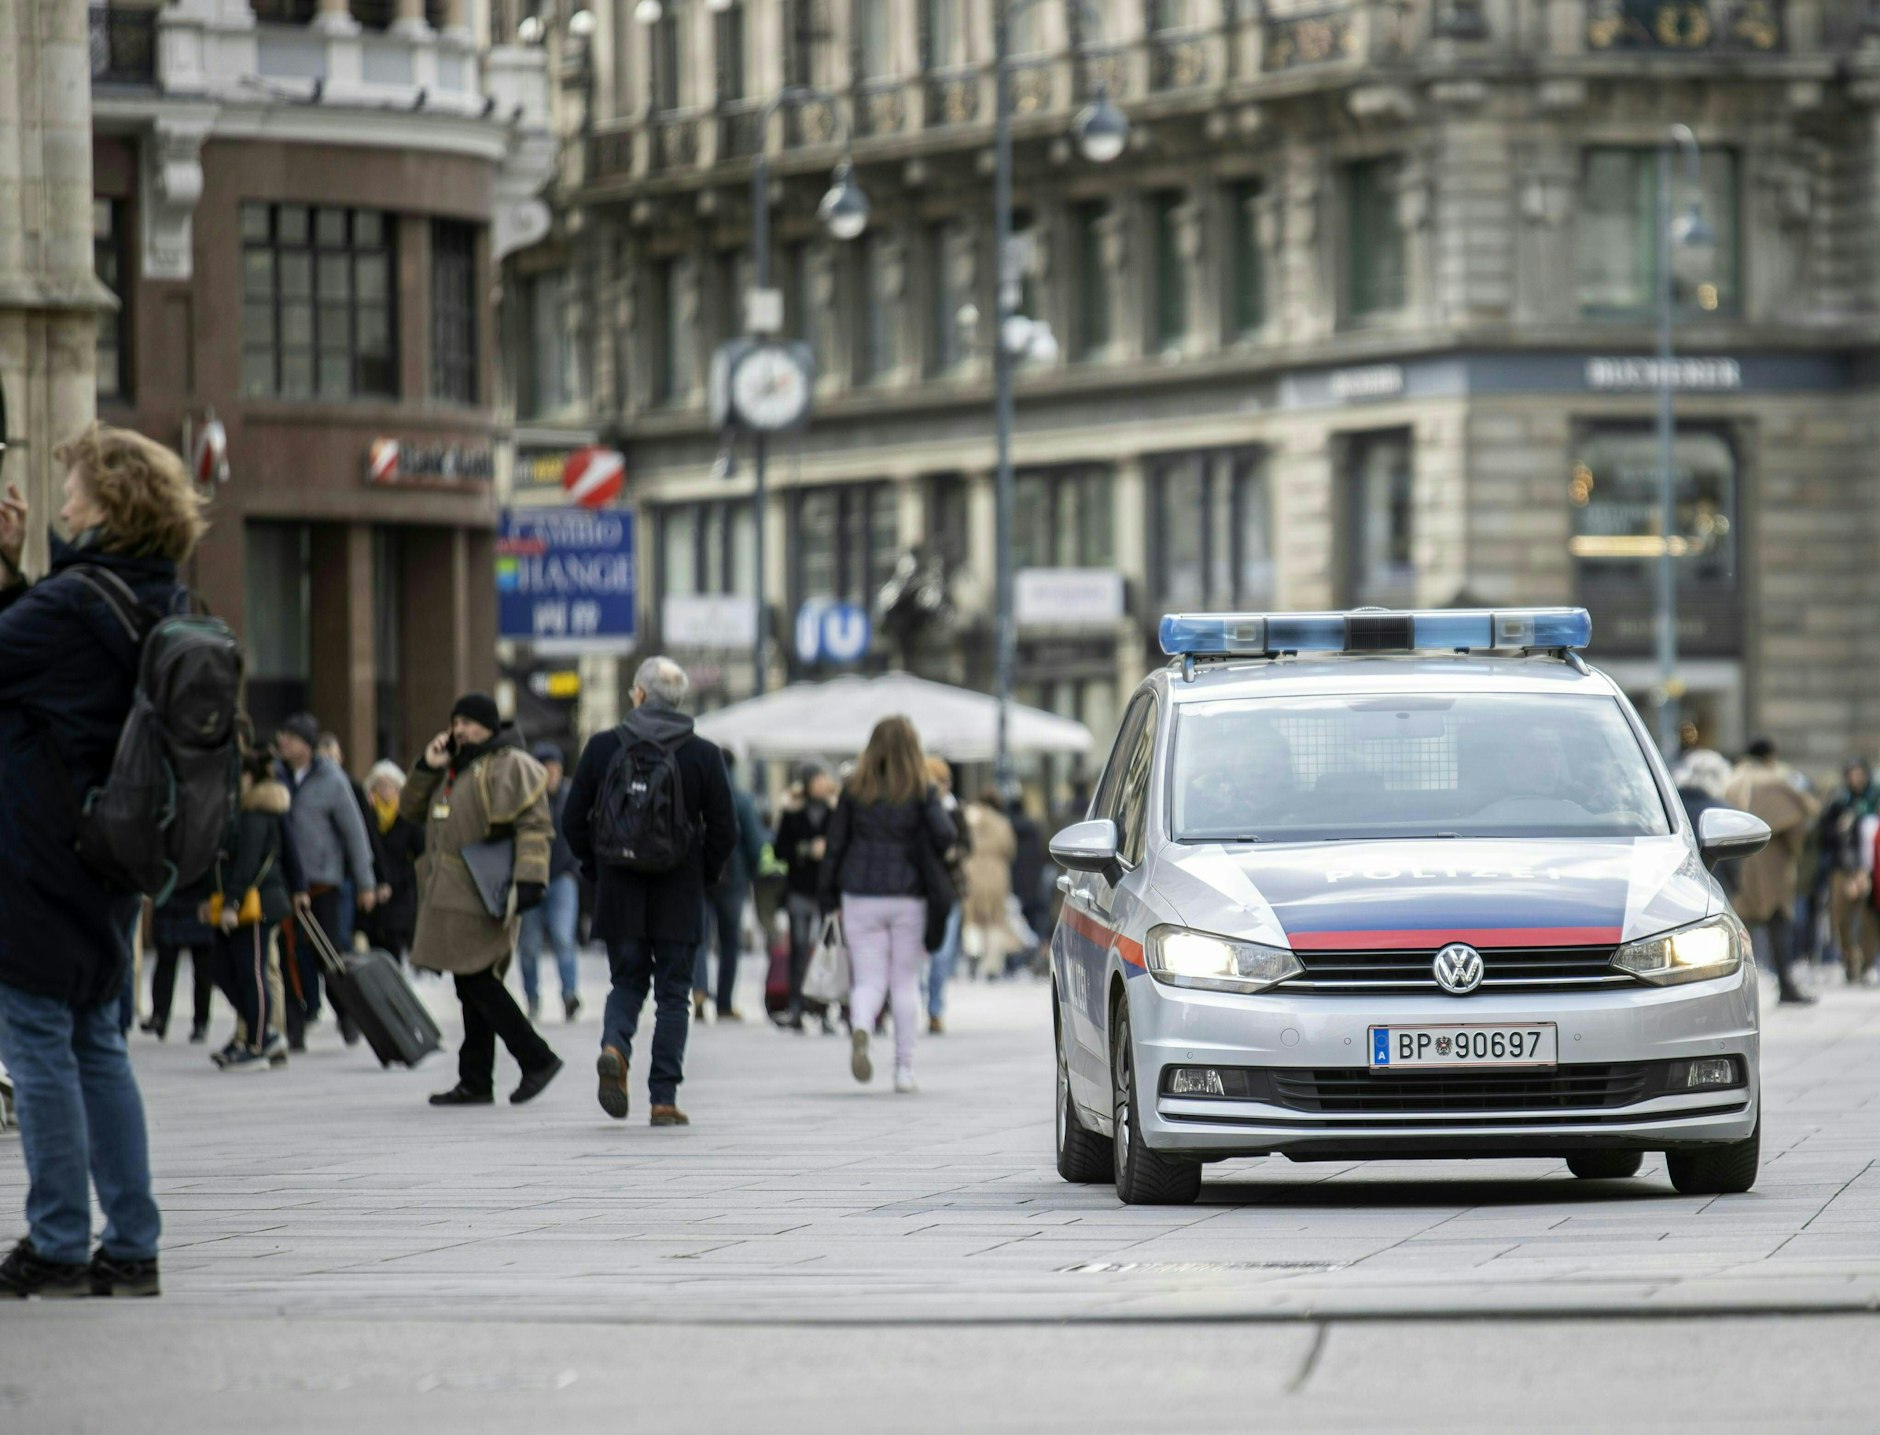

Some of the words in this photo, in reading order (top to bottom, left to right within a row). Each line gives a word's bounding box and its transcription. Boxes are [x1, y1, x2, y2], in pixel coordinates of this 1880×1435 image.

[516, 553, 634, 594] HANGE
[826, 606, 866, 658] U
[1325, 866, 1561, 882] POLIZEI
[1439, 948, 1480, 989] VW
[1377, 1051, 1386, 1060] A
[1399, 1033, 1431, 1059] BP
[1455, 1032, 1541, 1058] 90697
